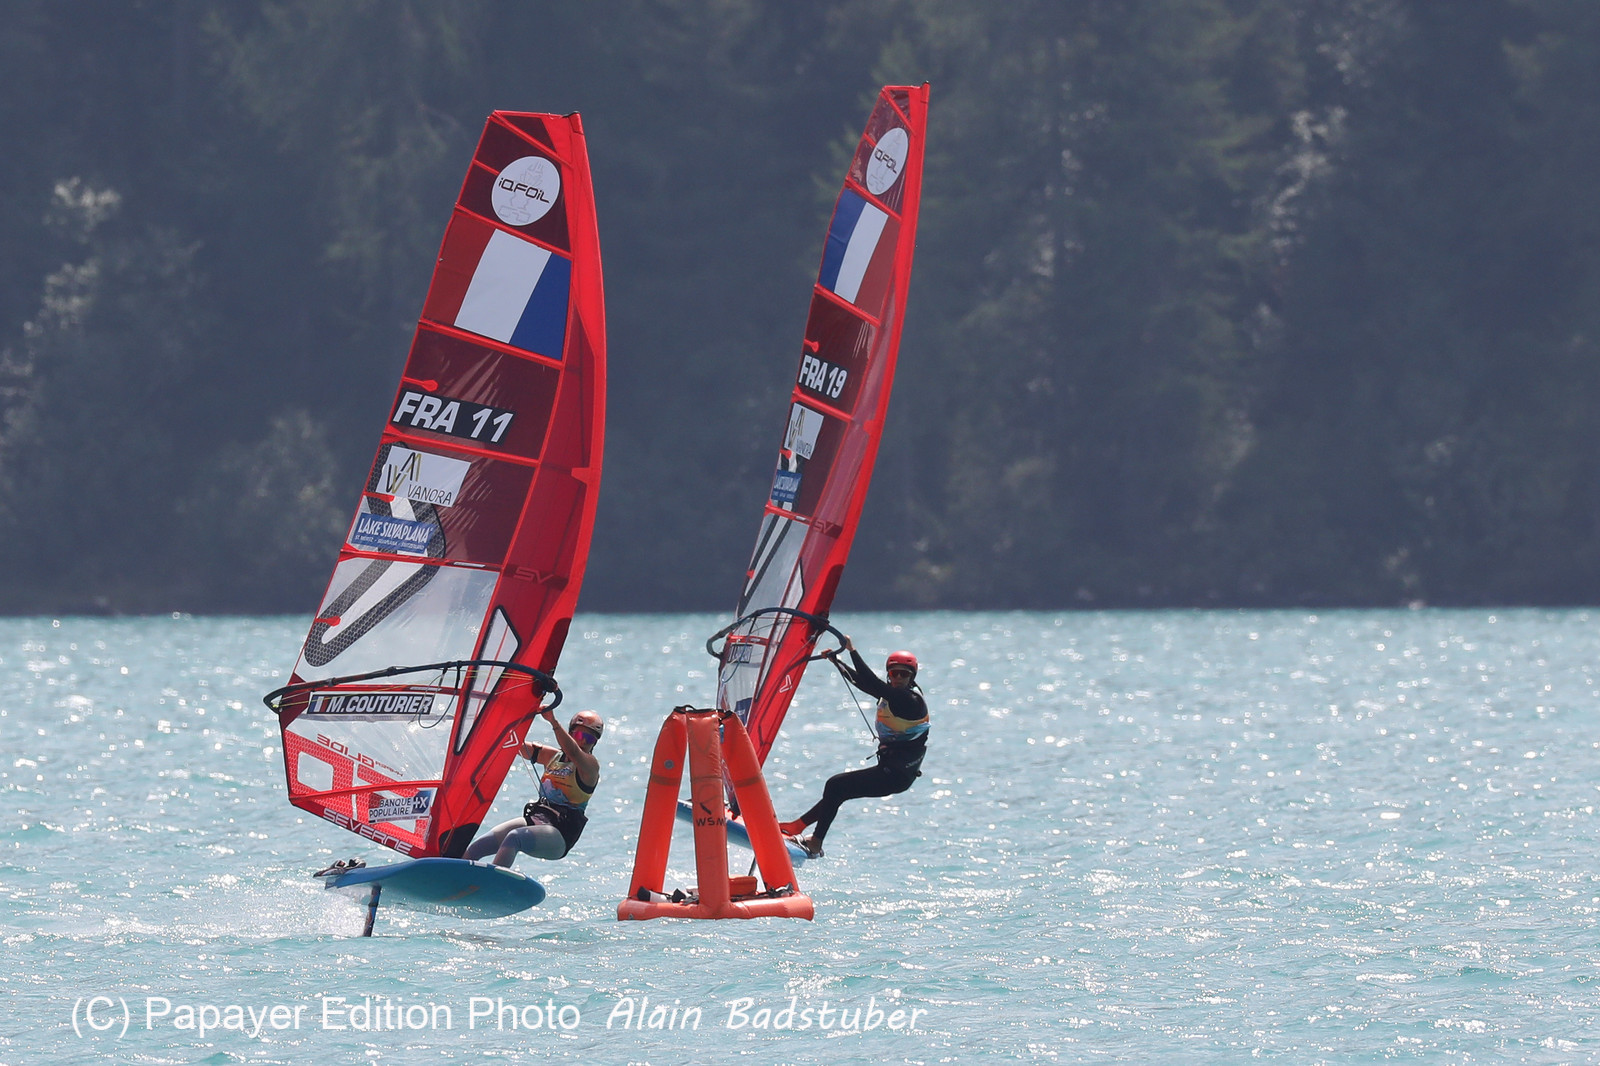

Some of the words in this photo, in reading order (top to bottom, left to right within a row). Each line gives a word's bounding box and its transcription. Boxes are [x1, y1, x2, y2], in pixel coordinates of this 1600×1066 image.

[798, 354, 828, 392] FRA
[826, 366, 848, 399] 19
[392, 391, 461, 433] FRA
[470, 407, 514, 443] 11
[407, 483, 453, 506] VANORA
[358, 517, 382, 536] LAKE
[380, 521, 431, 544] SILVAPLANA
[326, 695, 432, 713] M.COUTURIER
[369, 806, 410, 818] POPULAIRE
[380, 797, 411, 808] BANQUE
[323, 807, 413, 854] SEVERNE
